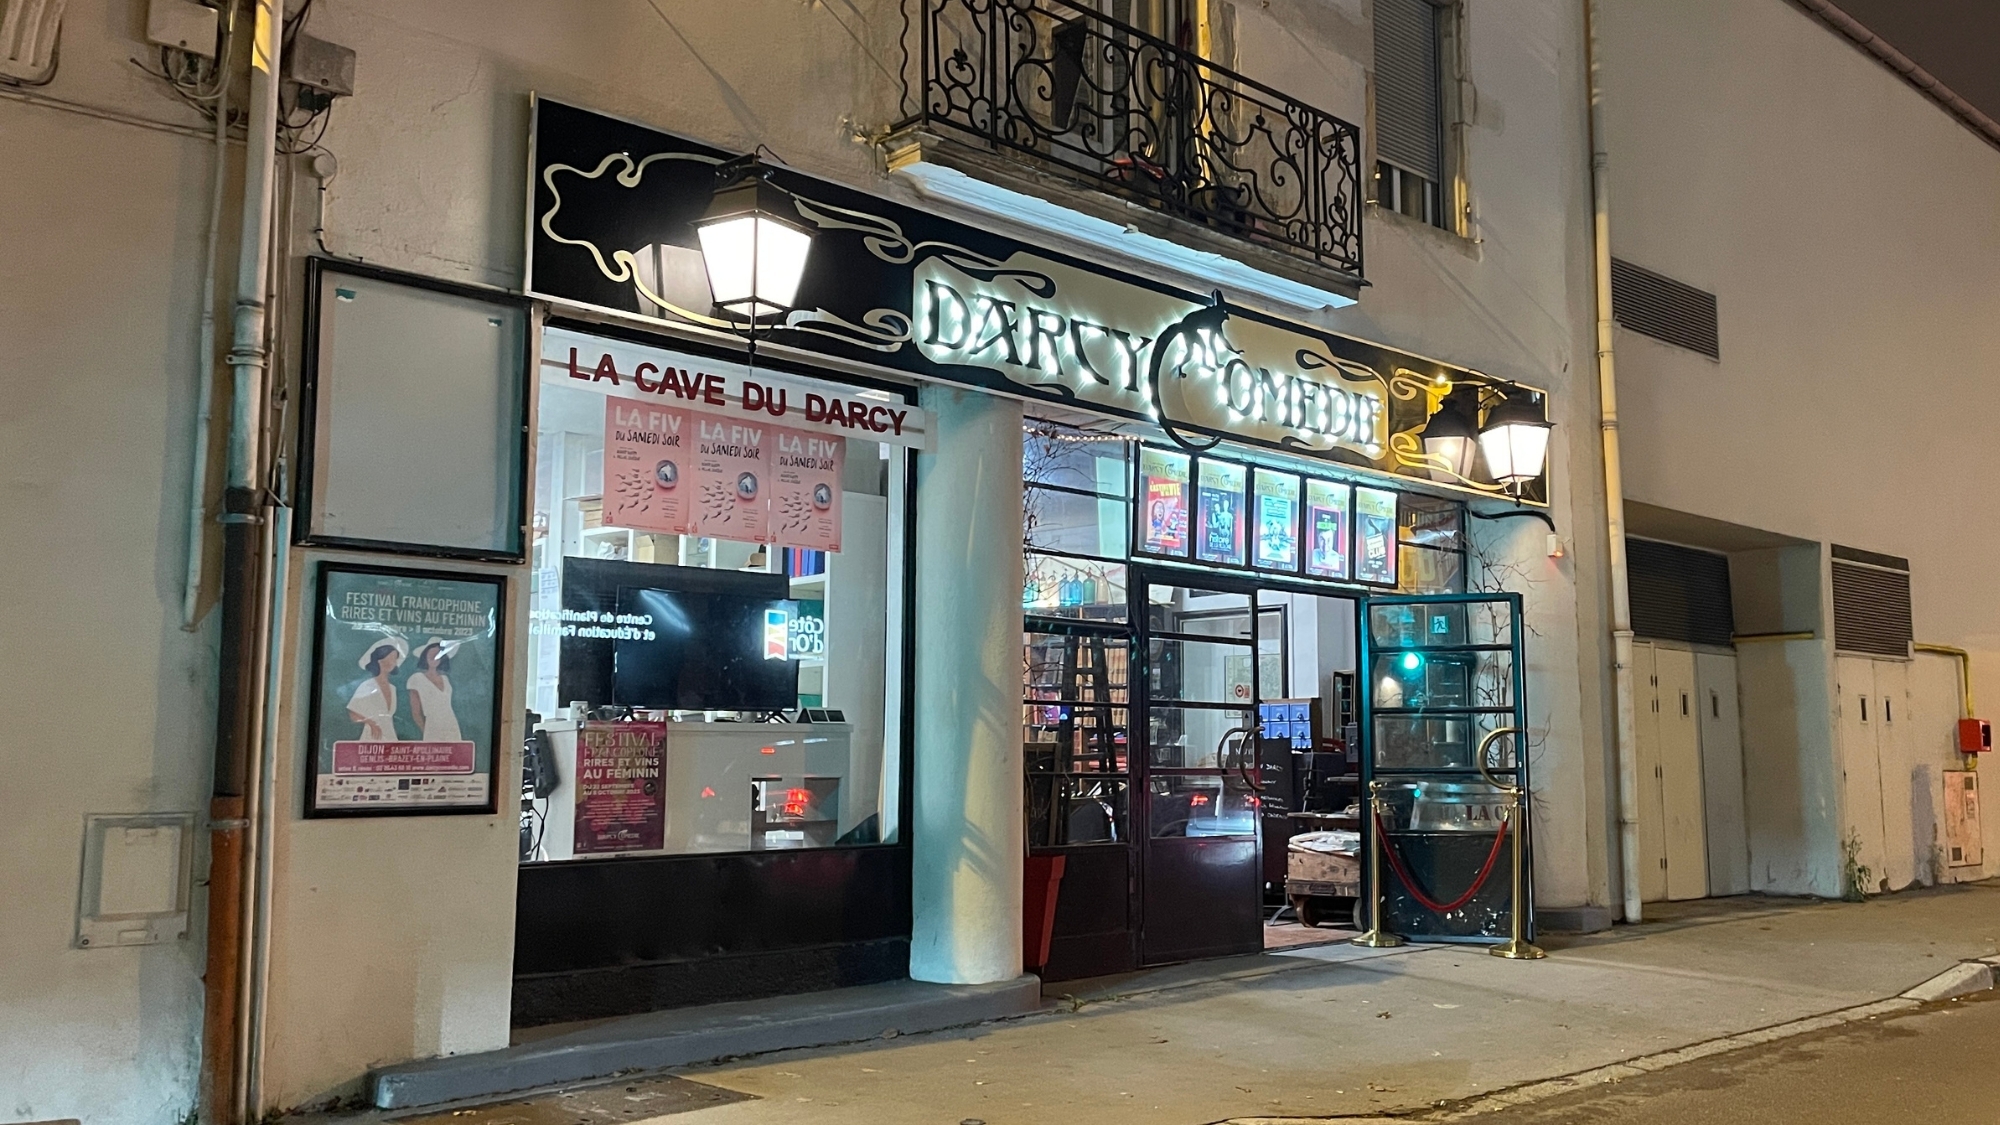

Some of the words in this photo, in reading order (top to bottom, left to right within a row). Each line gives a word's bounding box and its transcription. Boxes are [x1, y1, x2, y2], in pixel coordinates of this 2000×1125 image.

[924, 278, 1153, 393] DARCY
[1148, 291, 1386, 450] COMEDIE
[569, 347, 620, 386] LA
[635, 362, 726, 407] CAVE
[742, 381, 787, 417] DU
[805, 393, 908, 436] DARCY
[615, 405, 642, 429] LA
[648, 411, 682, 434] FIV
[626, 429, 660, 446] SAMEDI
[662, 434, 681, 448] SOIR
[700, 420, 725, 440] LA
[731, 425, 762, 447] FIV
[712, 443, 742, 458] SAMEDI
[779, 433, 802, 453] LA
[807, 438, 838, 459] FIV
[790, 455, 817, 470] SAMEDI
[819, 459, 834, 472] SOIR
[346, 592, 399, 608] FESTIVAL
[402, 595, 482, 614] FRANCOPHONE
[341, 606, 375, 620] RIRES
[378, 607, 393, 621] ET
[396, 610, 422, 623] VINS
[424, 612, 440, 624] AU
[443, 613, 487, 628] FEMININ
[585, 732, 660, 747] FESTIVAL
[358, 744, 385, 755] DIJON
[584, 747, 660, 758] FRANCOPHONE
[583, 758, 615, 767] RIRES
[618, 758, 631, 767] ET
[634, 757, 659, 766] VINS
[583, 769, 602, 779] AU
[606, 768, 659, 779] FEMININ
[1465, 804, 1491, 821] LA
